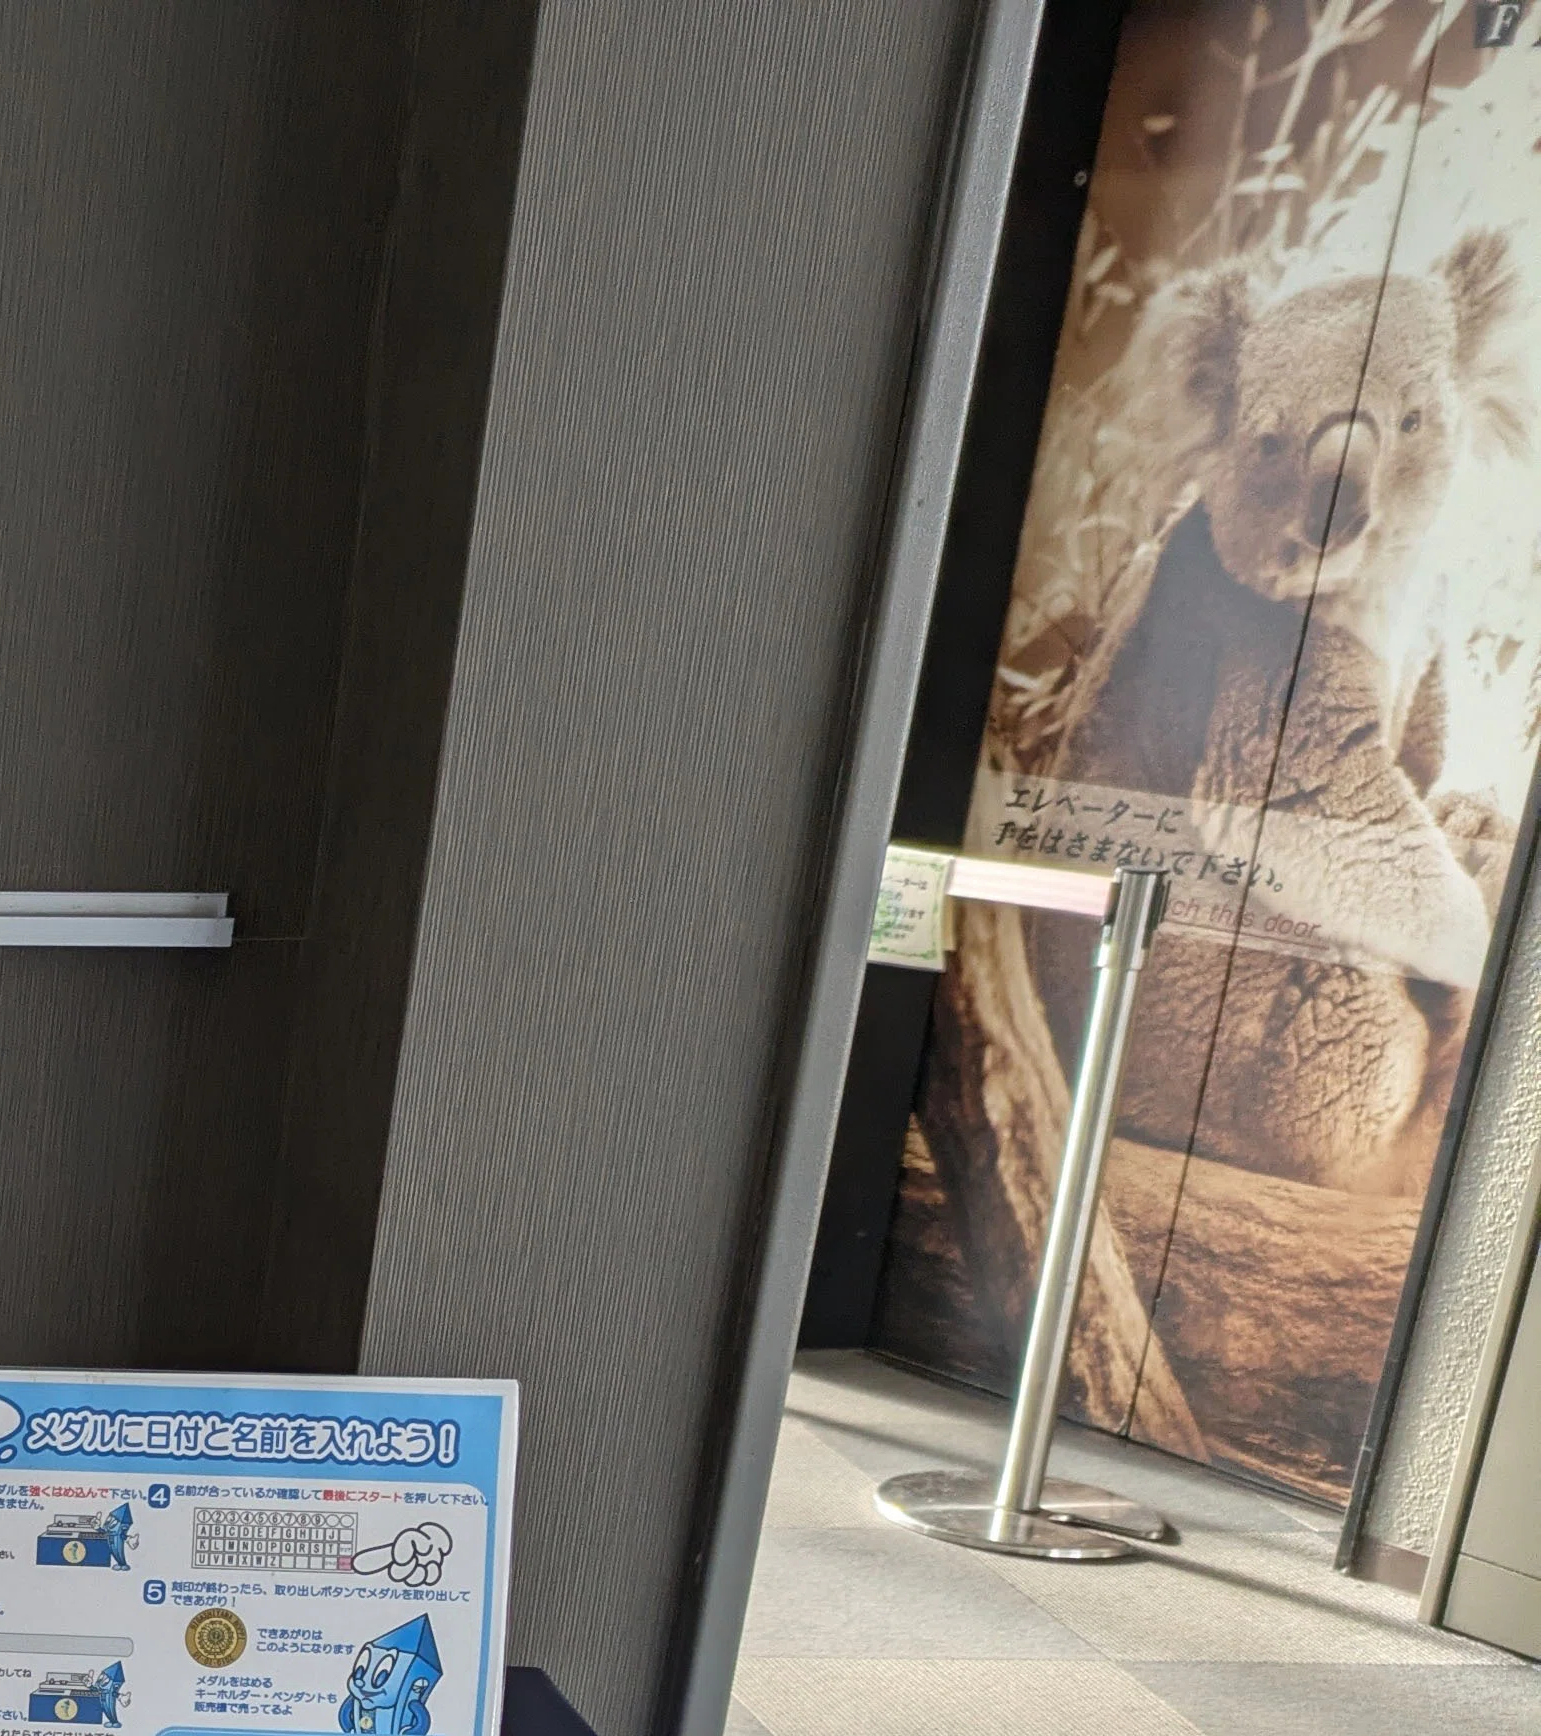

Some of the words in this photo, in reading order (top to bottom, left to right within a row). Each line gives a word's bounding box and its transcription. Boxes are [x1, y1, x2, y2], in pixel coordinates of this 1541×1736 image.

[1006, 788, 1184, 834] エレベーターに
[995, 821, 1283, 893] 手をはさまないで下さい。
[1207, 903, 1254, 927] this
[30, 1415, 454, 1463] メダルに日付と名前を入れよう！
[151, 1486, 167, 1505] 4
[147, 1584, 163, 1601] 5
[171, 1595, 236, 1607] できあがり！
[257, 1629, 322, 1640] できあがりは
[256, 1641, 355, 1655] このようになります
[196, 1676, 273, 1688] メダルをはめる
[195, 1689, 337, 1703] キーホルダー・ペンダントも
[194, 1702, 293, 1716] 販売機で売ってるよ
